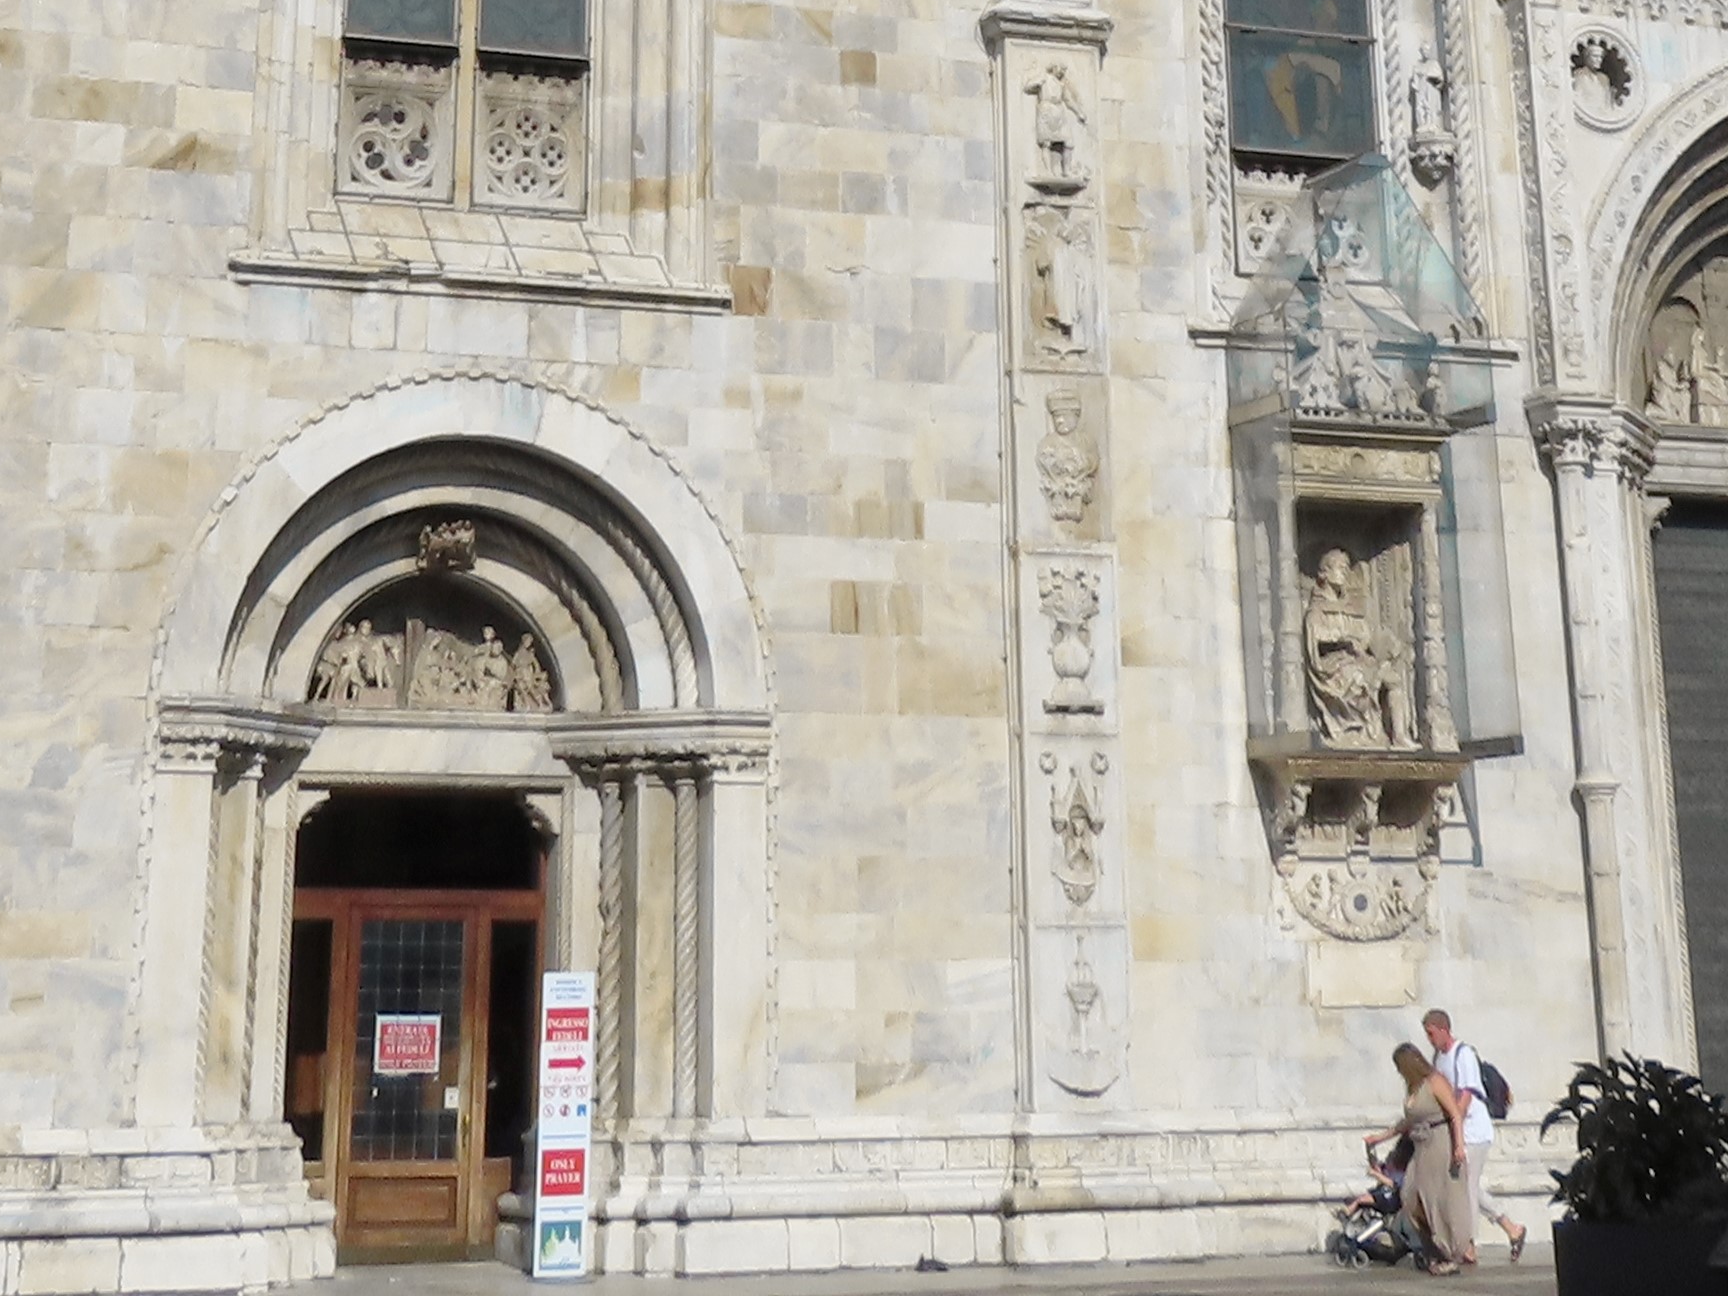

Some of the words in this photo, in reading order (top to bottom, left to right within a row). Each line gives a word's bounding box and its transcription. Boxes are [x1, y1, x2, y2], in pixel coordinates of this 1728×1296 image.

[547, 1017, 589, 1028] INGRESSO
[550, 1158, 576, 1170] ONLY
[545, 1172, 581, 1185] PRAYER
